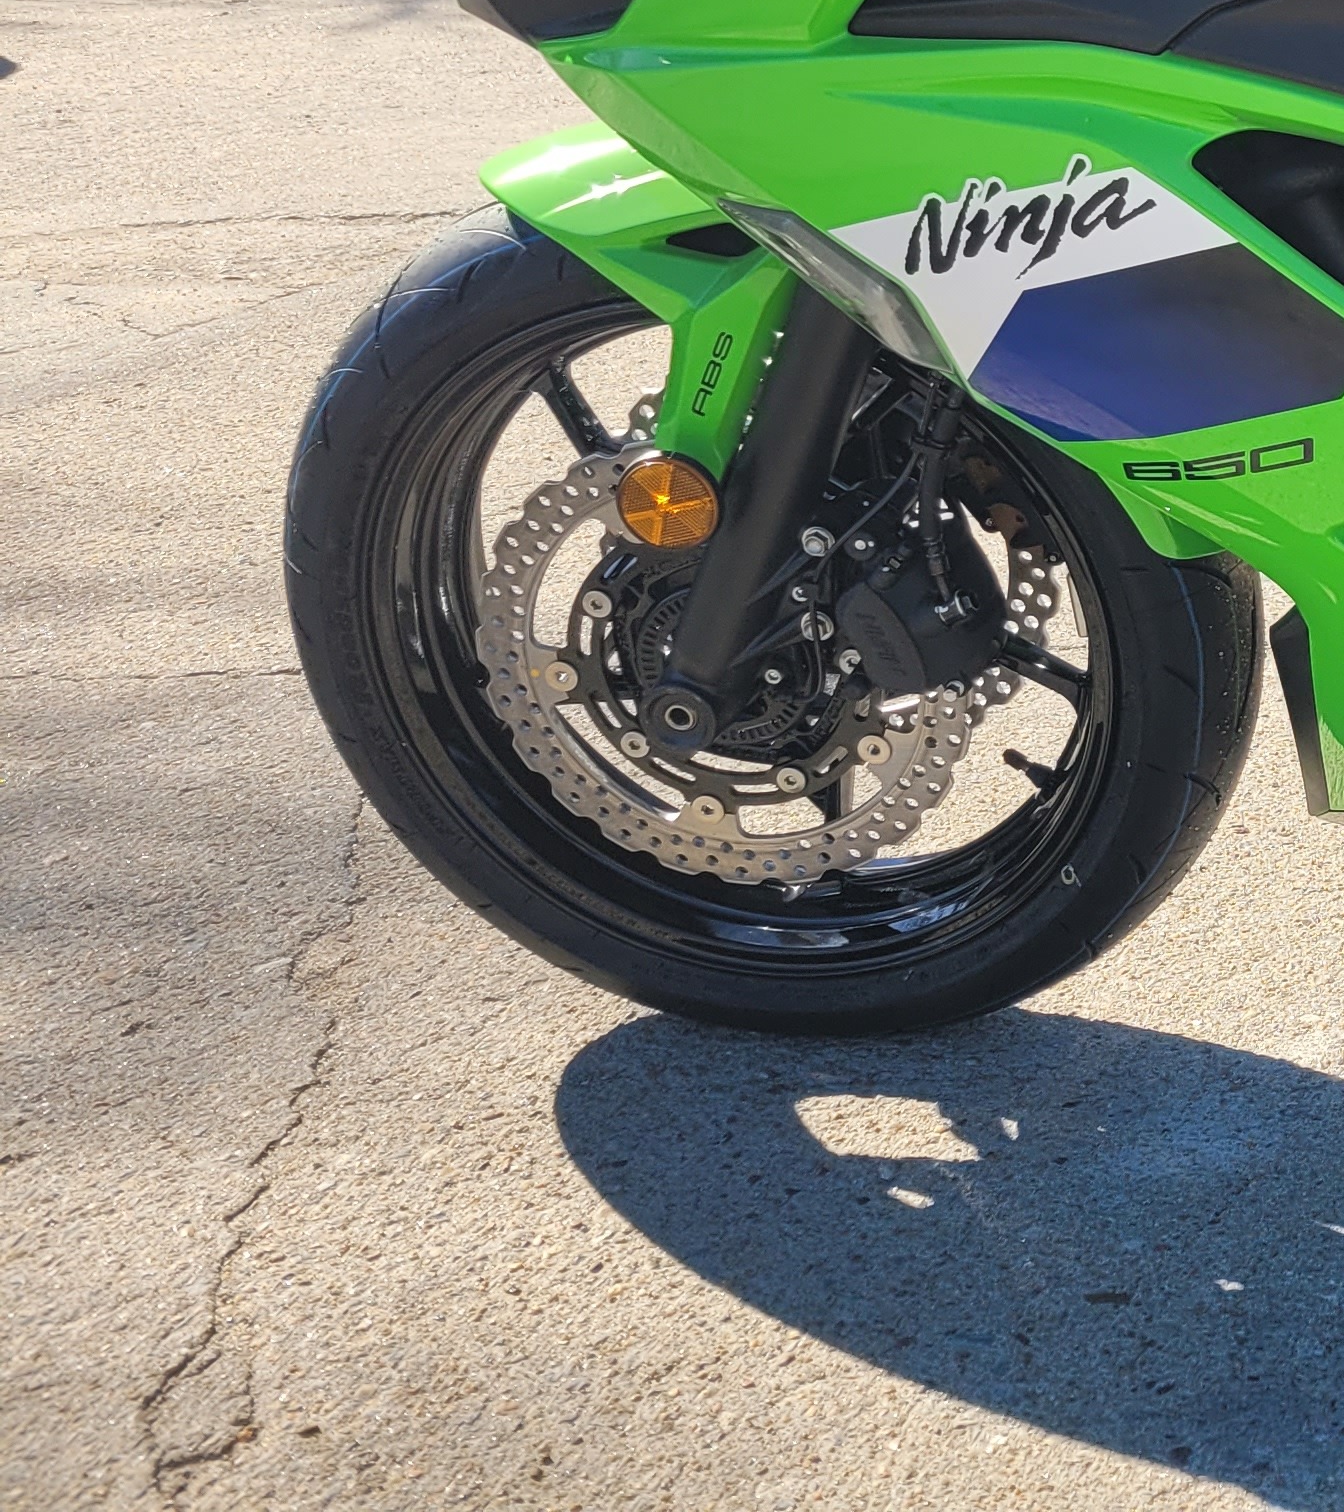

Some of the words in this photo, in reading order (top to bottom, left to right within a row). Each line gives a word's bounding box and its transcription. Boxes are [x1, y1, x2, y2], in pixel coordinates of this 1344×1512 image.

[905, 158, 1157, 280] Ninja
[691, 331, 733, 417] ABS
[1122, 437, 1314, 481] 650
